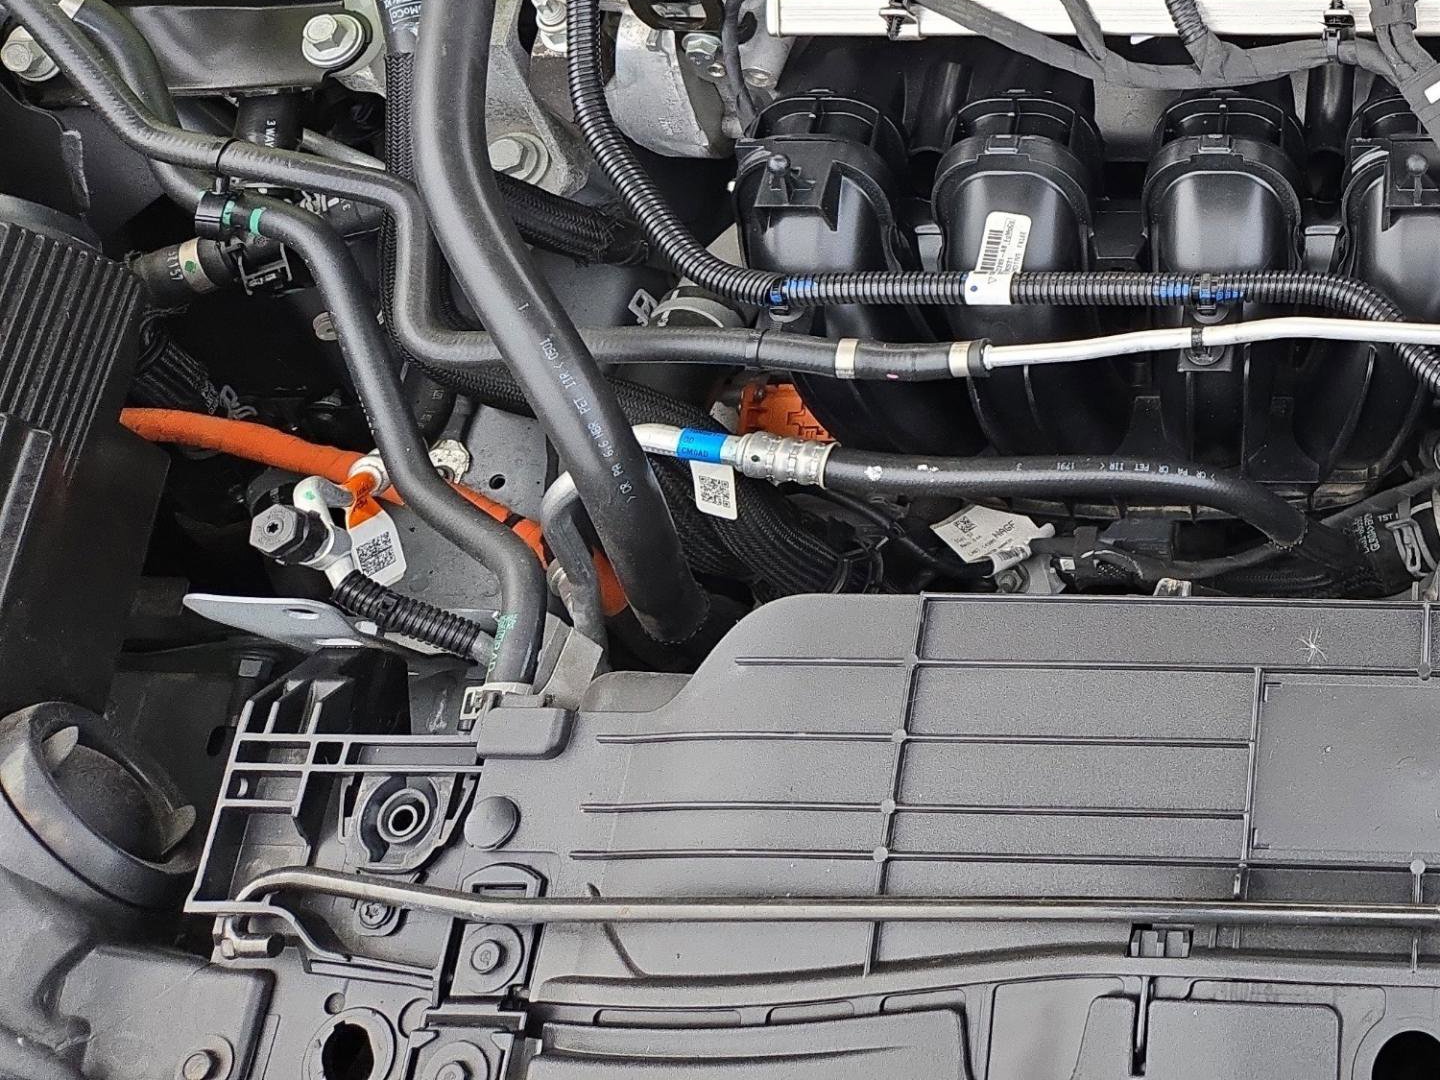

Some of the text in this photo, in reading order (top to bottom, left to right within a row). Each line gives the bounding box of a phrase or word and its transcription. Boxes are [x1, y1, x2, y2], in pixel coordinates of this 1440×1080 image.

[573, 396, 591, 415] PET
[611, 463, 624, 478] PA
[1134, 463, 1150, 471] PET
[619, 480, 633, 496] CR
